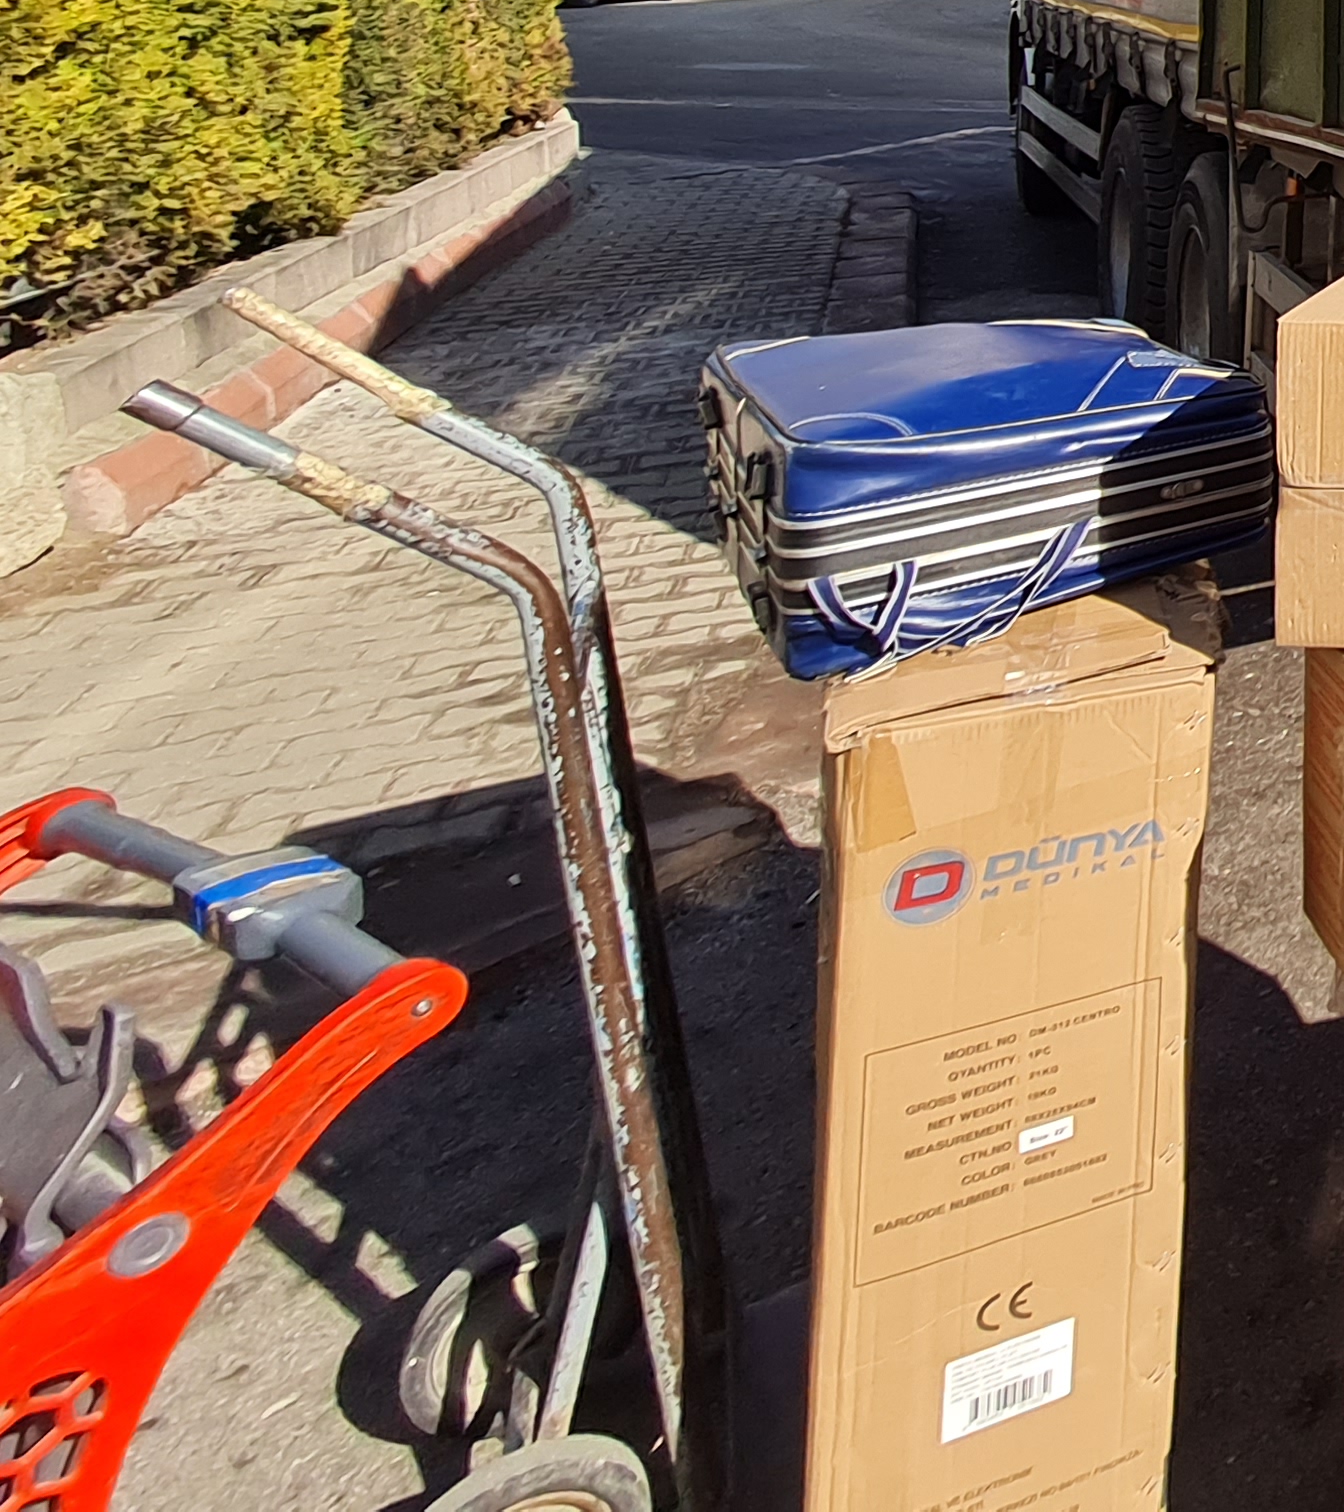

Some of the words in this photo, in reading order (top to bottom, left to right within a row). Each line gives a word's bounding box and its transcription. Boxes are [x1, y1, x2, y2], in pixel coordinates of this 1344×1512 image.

[943, 1040, 993, 1063] MODEL
[1072, 1005, 1121, 1027] CENTRO
[905, 1092, 957, 1116] GROSS
[927, 1115, 954, 1132] NET
[1023, 1149, 1058, 1167] GREY
[873, 1204, 946, 1236] BARCODE
